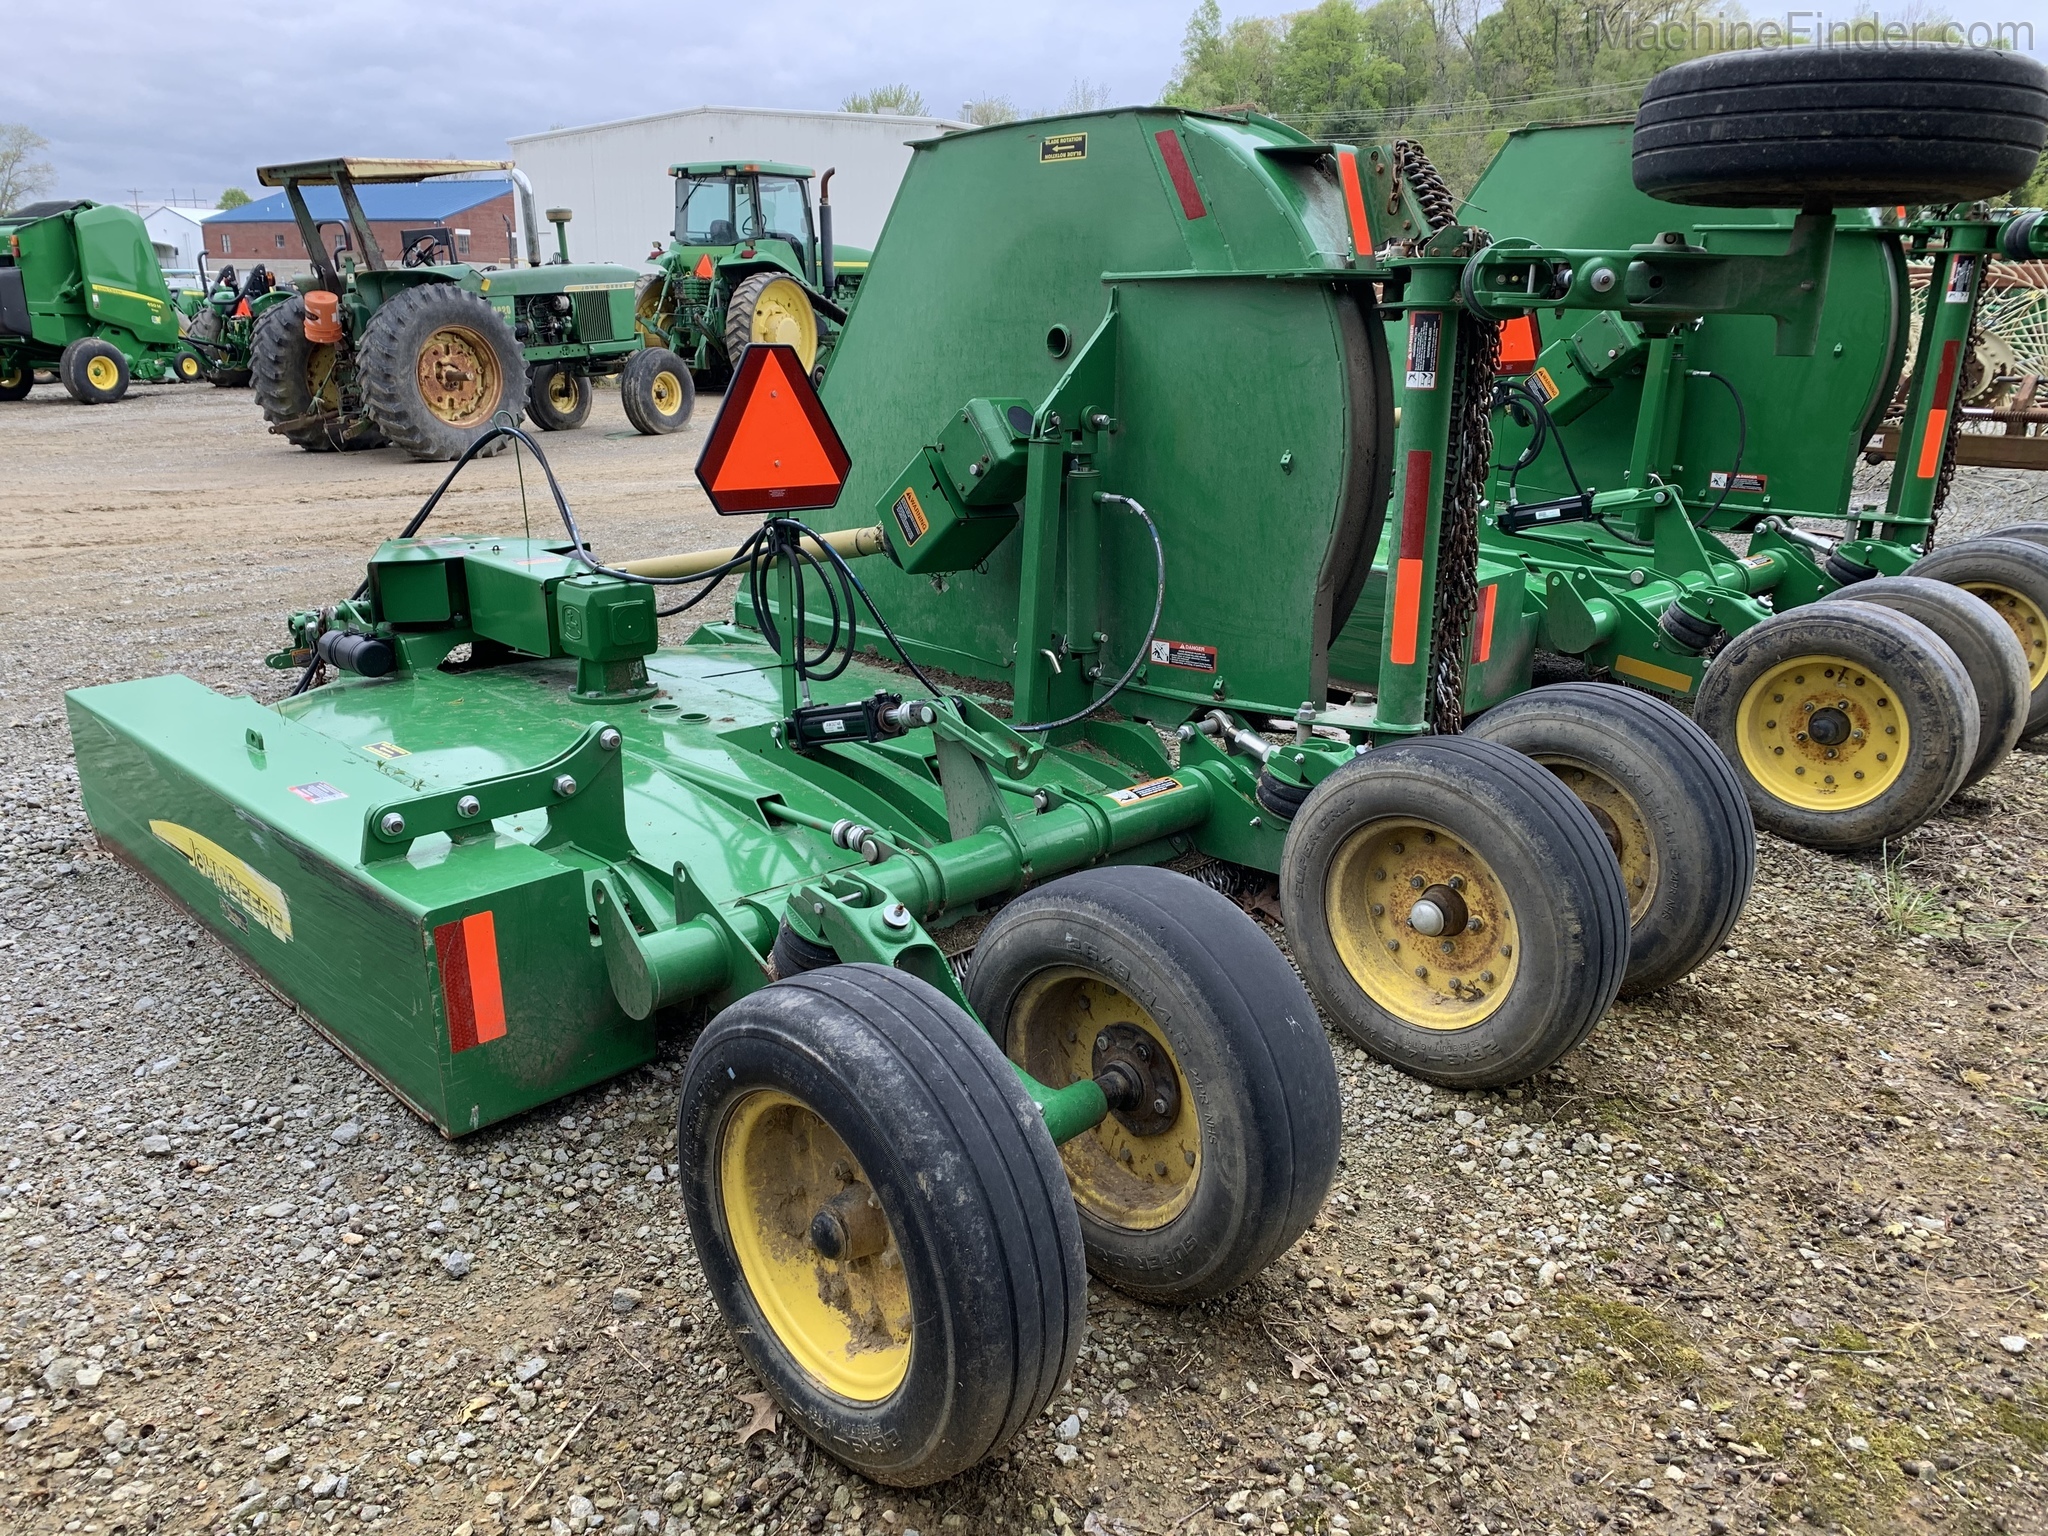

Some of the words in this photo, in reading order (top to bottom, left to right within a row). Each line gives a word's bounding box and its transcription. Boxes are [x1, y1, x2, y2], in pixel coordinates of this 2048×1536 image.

[910, 498, 927, 530] WARNING
[1185, 644, 1205, 652] DANGER
[1295, 831, 1320, 899] SUPER
[1319, 797, 1355, 831] GRIP
[1133, 1233, 1199, 1272] SUPER
